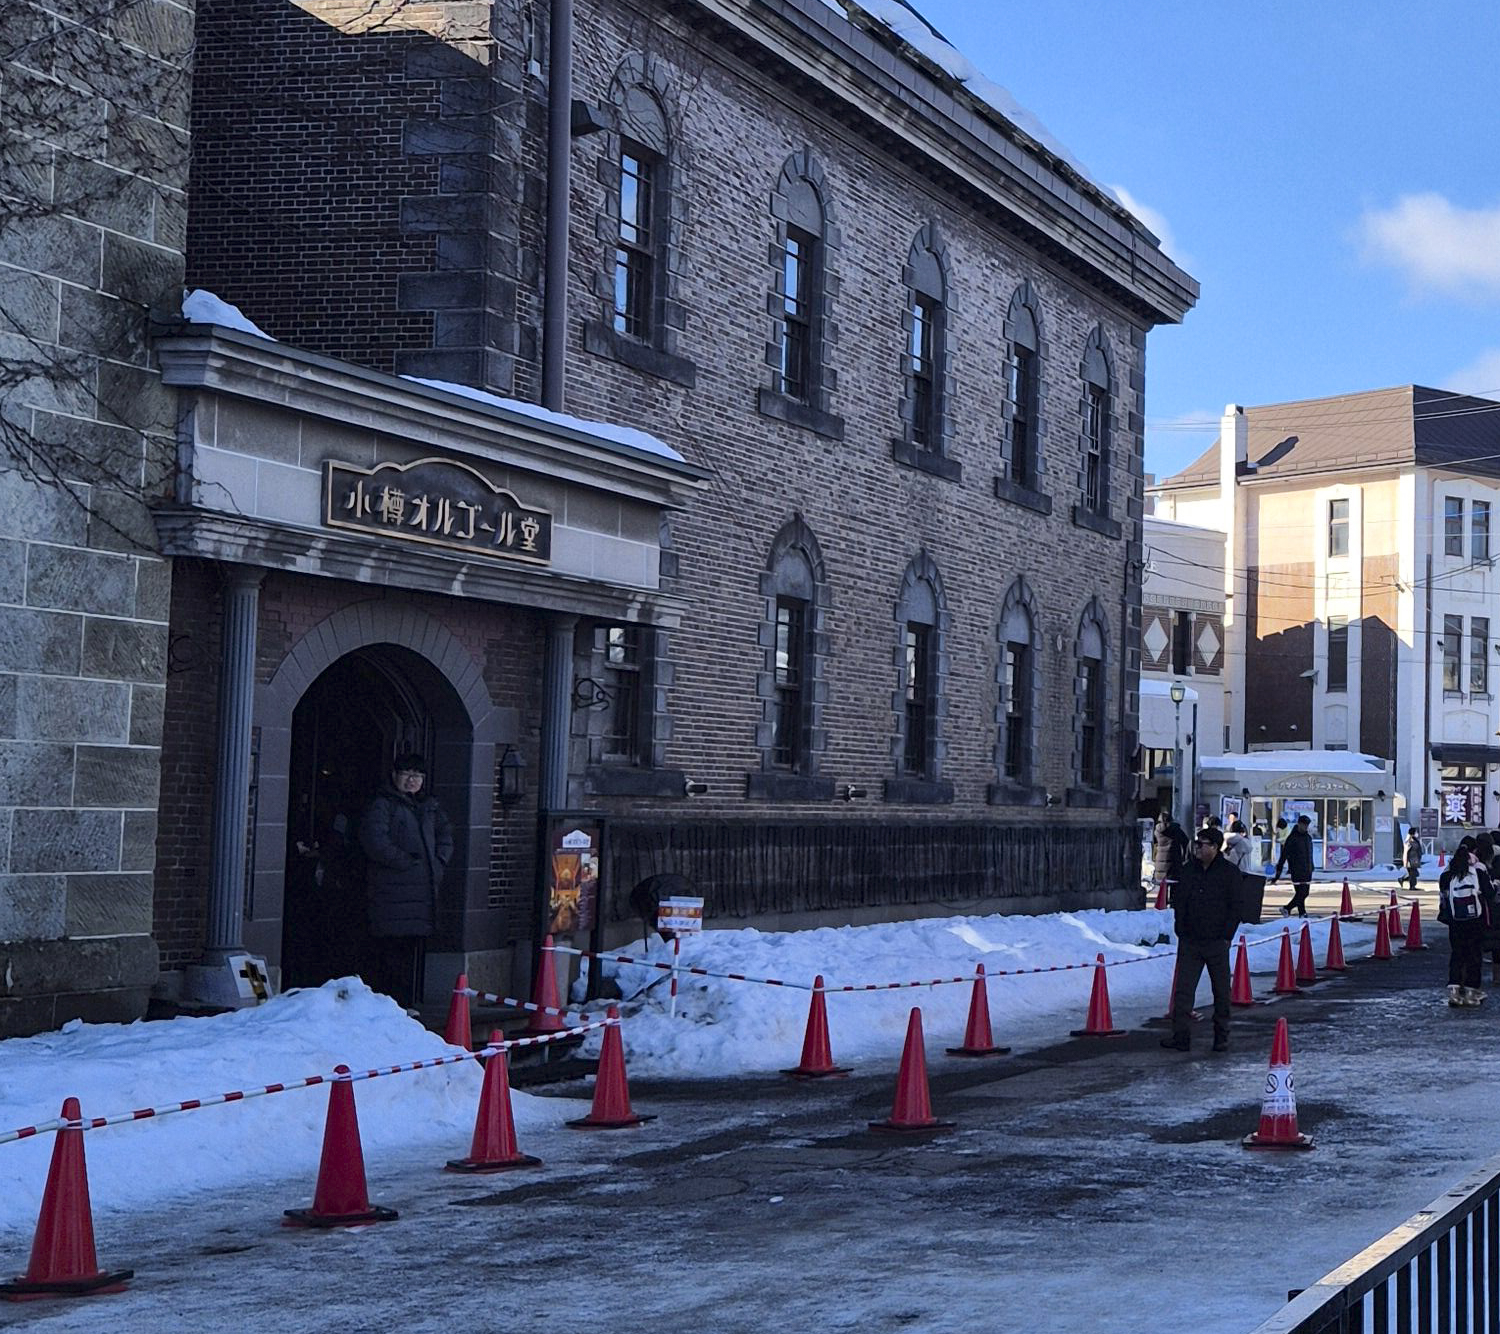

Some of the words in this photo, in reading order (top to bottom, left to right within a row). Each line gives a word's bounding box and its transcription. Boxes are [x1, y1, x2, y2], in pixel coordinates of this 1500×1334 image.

[346, 479, 540, 553] 小樽オルゴール堂
[1445, 793, 1467, 823] 薬
